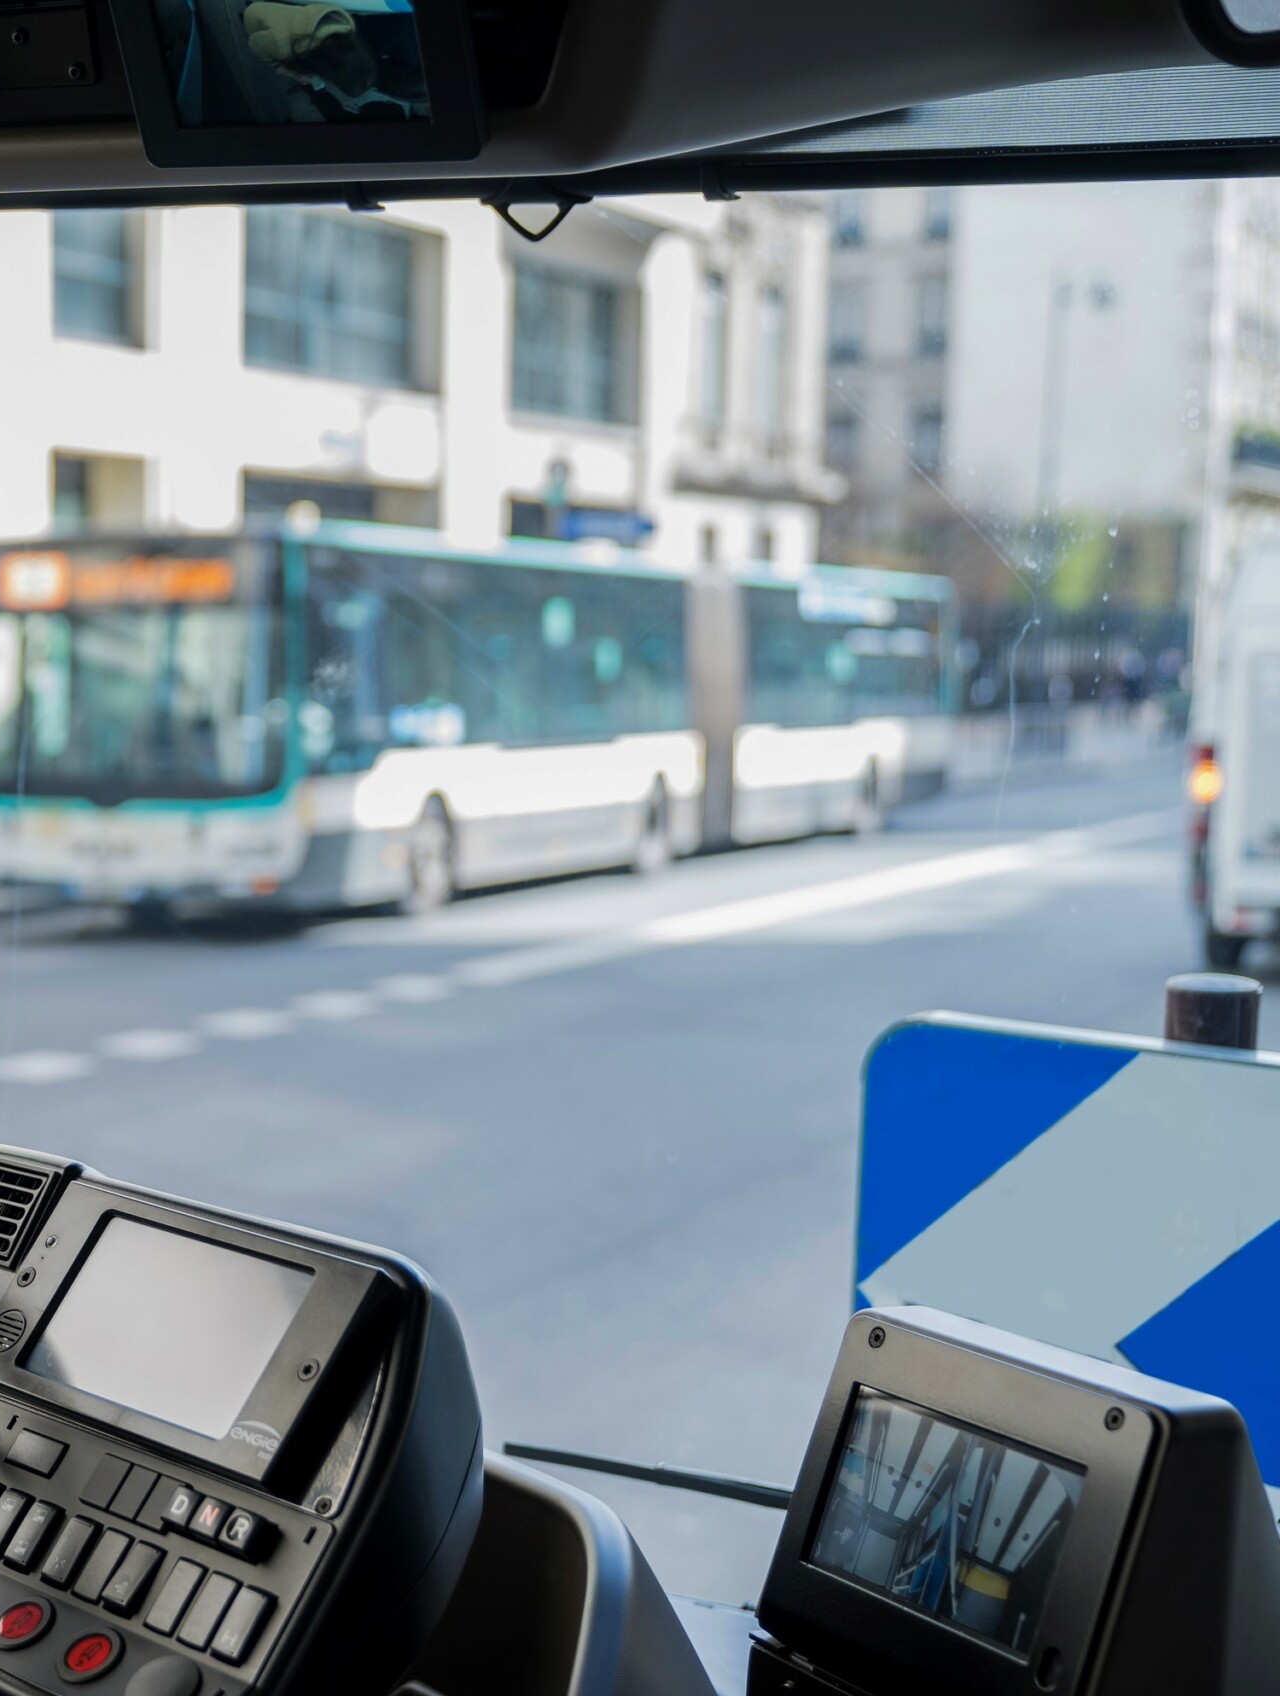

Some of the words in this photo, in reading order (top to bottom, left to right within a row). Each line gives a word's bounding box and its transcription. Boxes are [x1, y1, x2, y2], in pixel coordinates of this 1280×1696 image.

[170, 1494, 190, 1515] D
[199, 1504, 220, 1527] N
[229, 1516, 250, 1540] R
